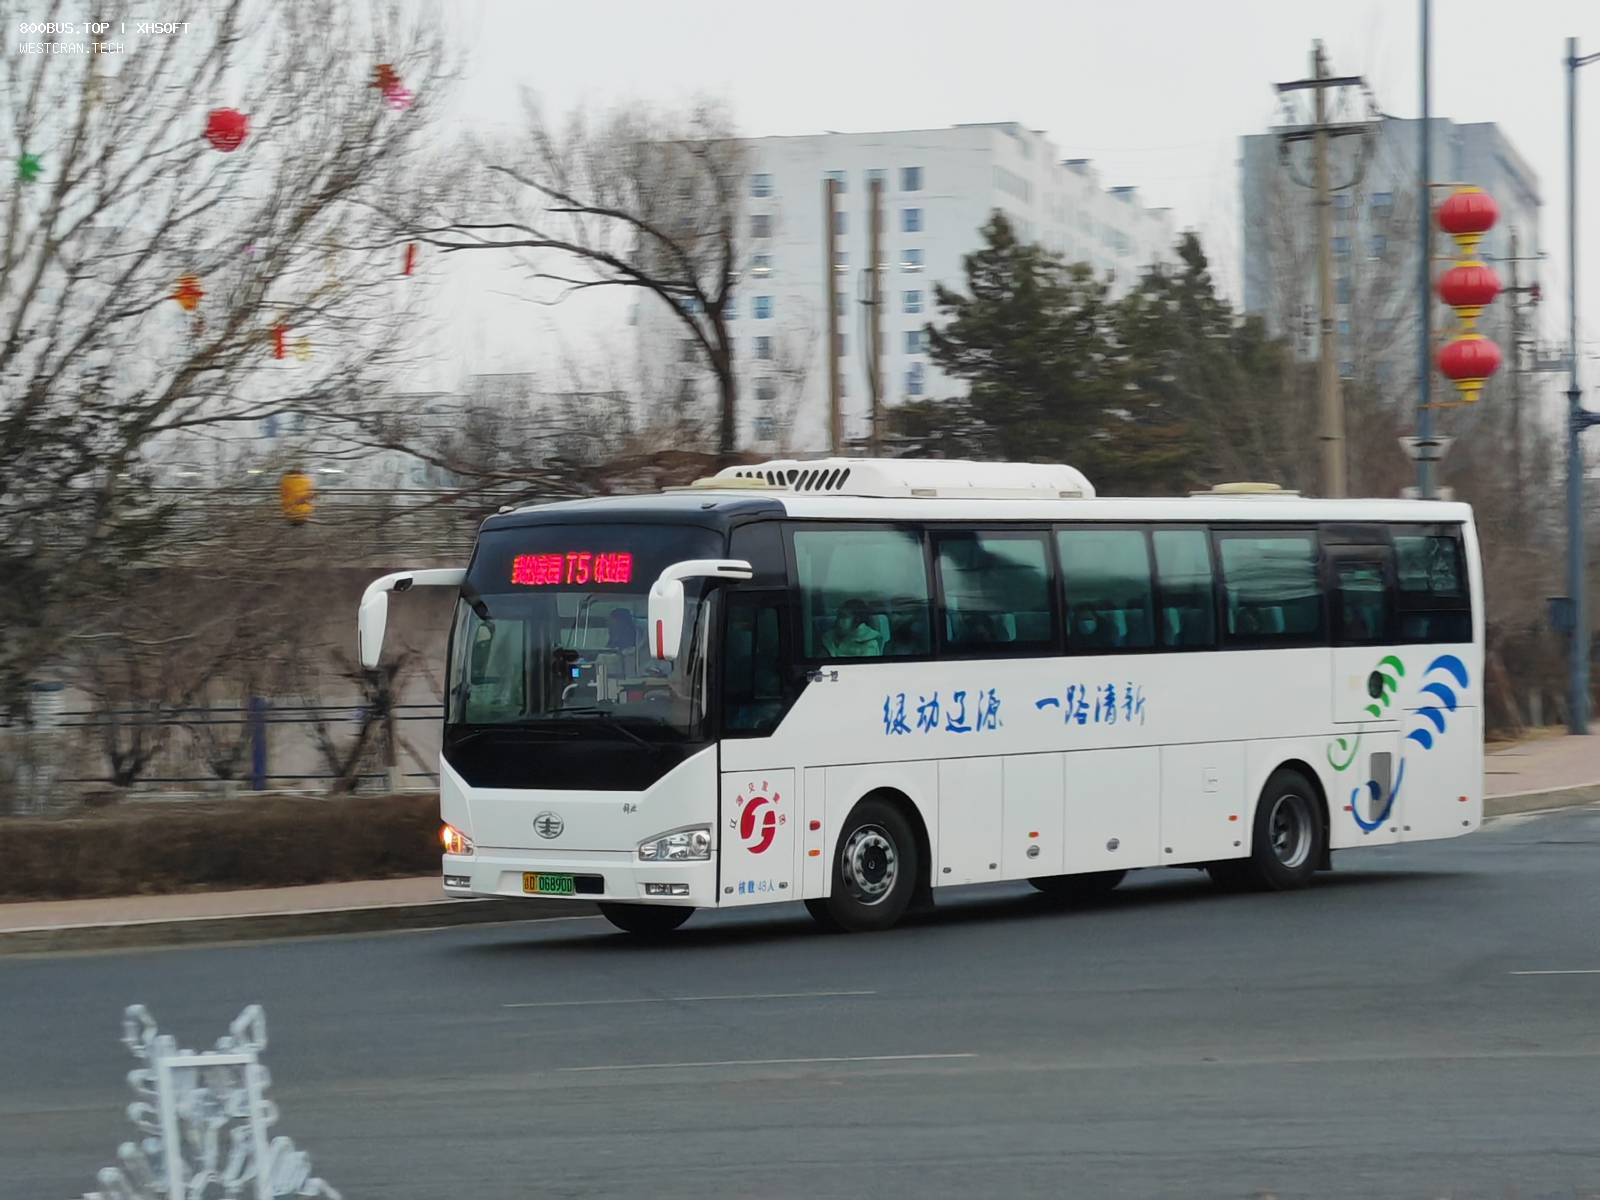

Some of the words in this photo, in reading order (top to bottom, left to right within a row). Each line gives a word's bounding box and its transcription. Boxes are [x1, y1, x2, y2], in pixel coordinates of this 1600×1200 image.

[883, 687, 1003, 736] 绿动辽源
[1035, 681, 1147, 727] 一路清新
